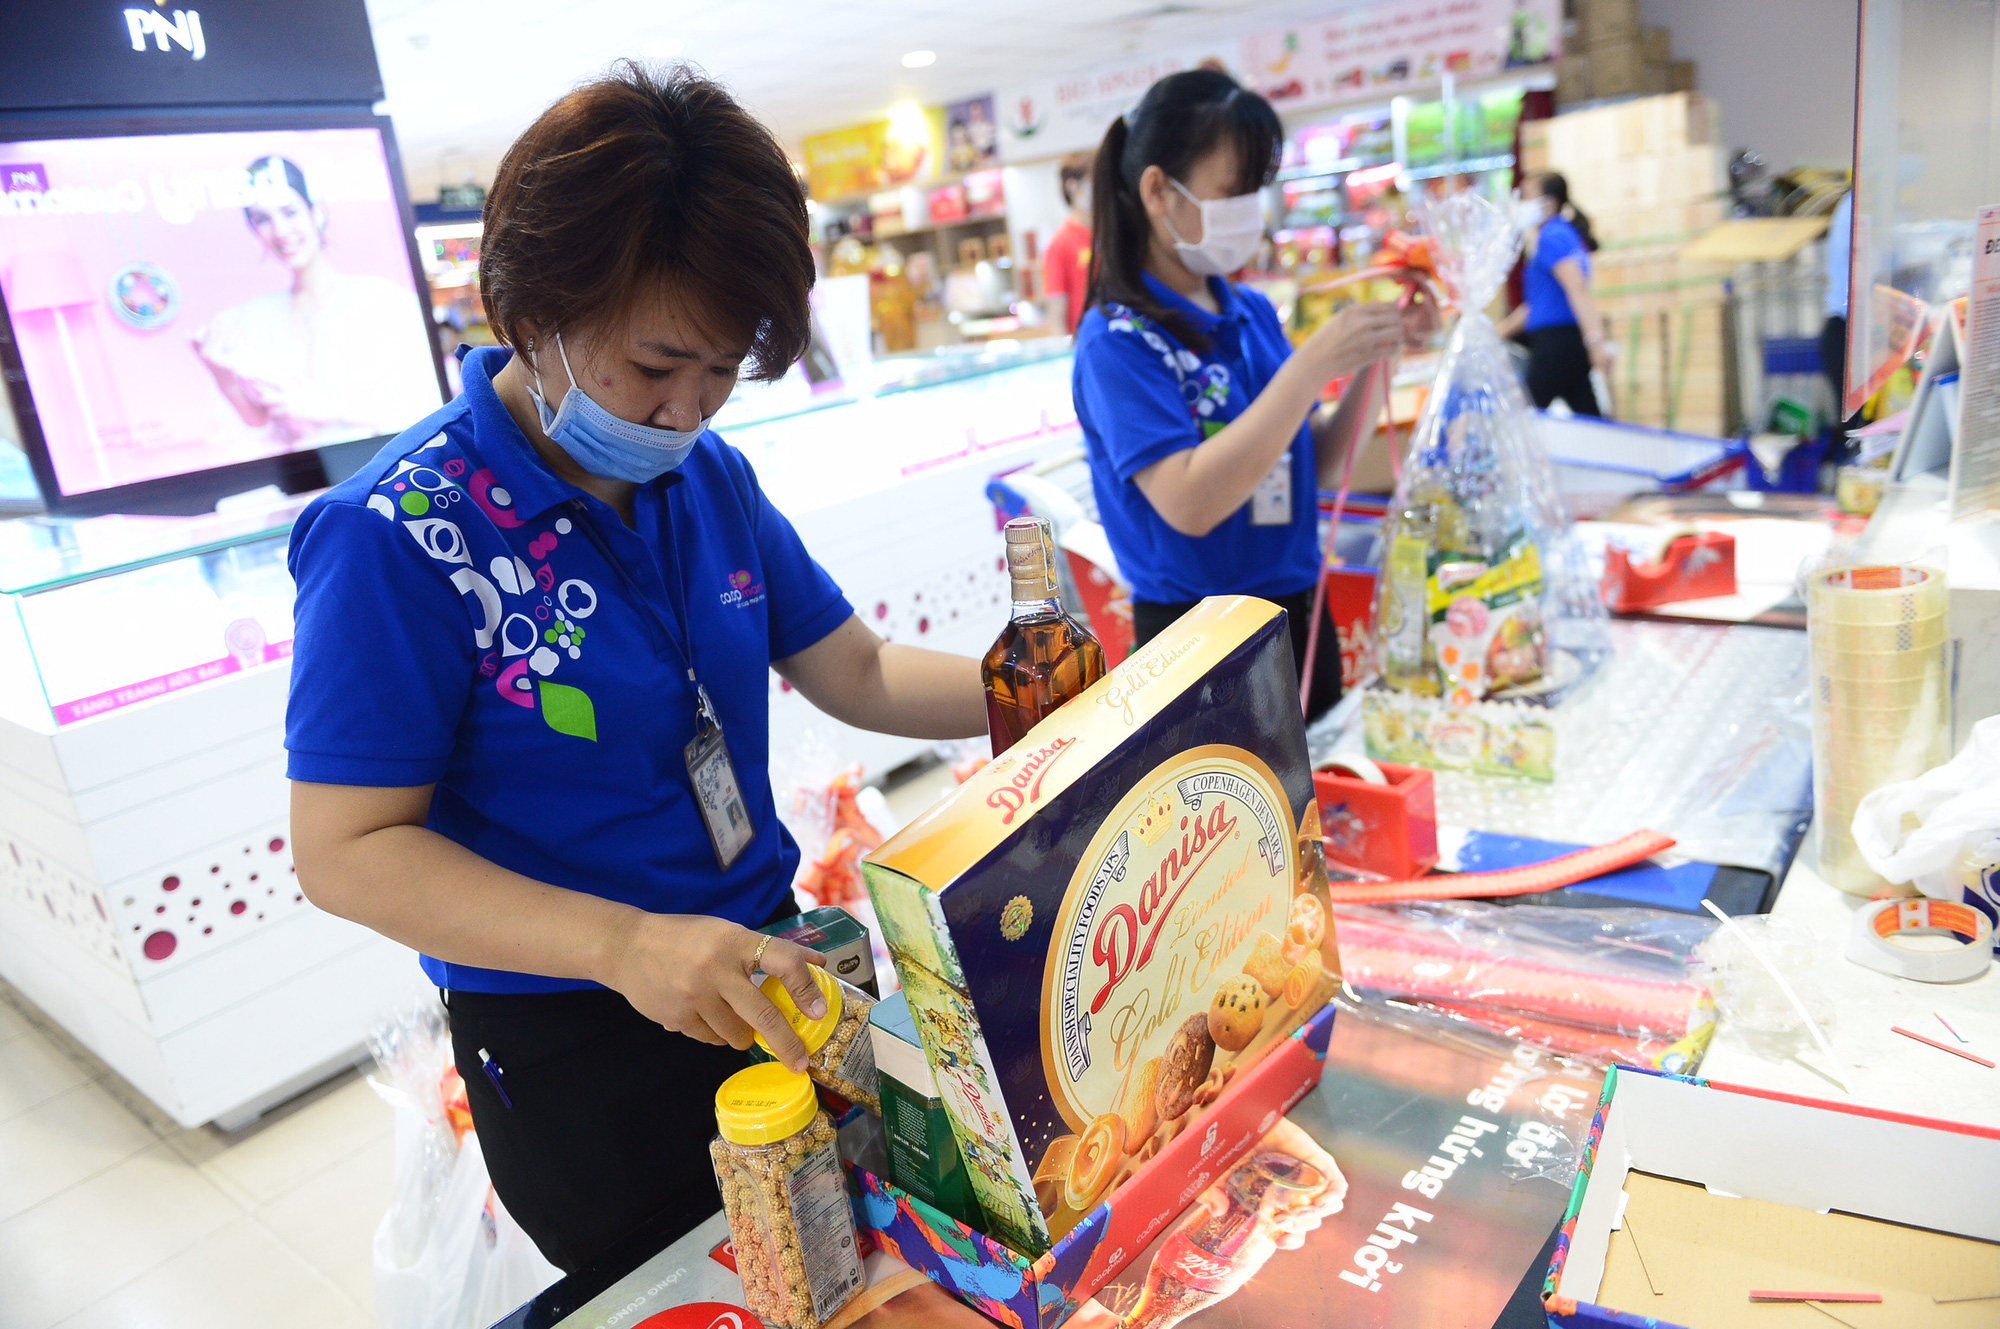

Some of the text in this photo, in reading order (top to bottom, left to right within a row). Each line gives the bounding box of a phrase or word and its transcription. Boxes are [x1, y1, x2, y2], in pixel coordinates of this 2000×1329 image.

[123, 9, 206, 60] PNJ
[1096, 635, 1201, 726] Gold Edition
[986, 736, 1077, 825] Danisa
[1193, 775, 1282, 860] COPENHAGEN DENMARK
[1090, 800, 1238, 1015] Danisa
[1170, 840, 1252, 949] Limited
[1064, 850, 1120, 1069] DANISH SPECIALITY FOODS APS
[1109, 894, 1273, 1112] Gold Edition
[957, 1071, 996, 1137] Danisa
[793, 1158, 815, 1178] Nutrition
[1401, 1115, 1499, 1199] hứng
[1337, 1201, 1434, 1293] khởi
